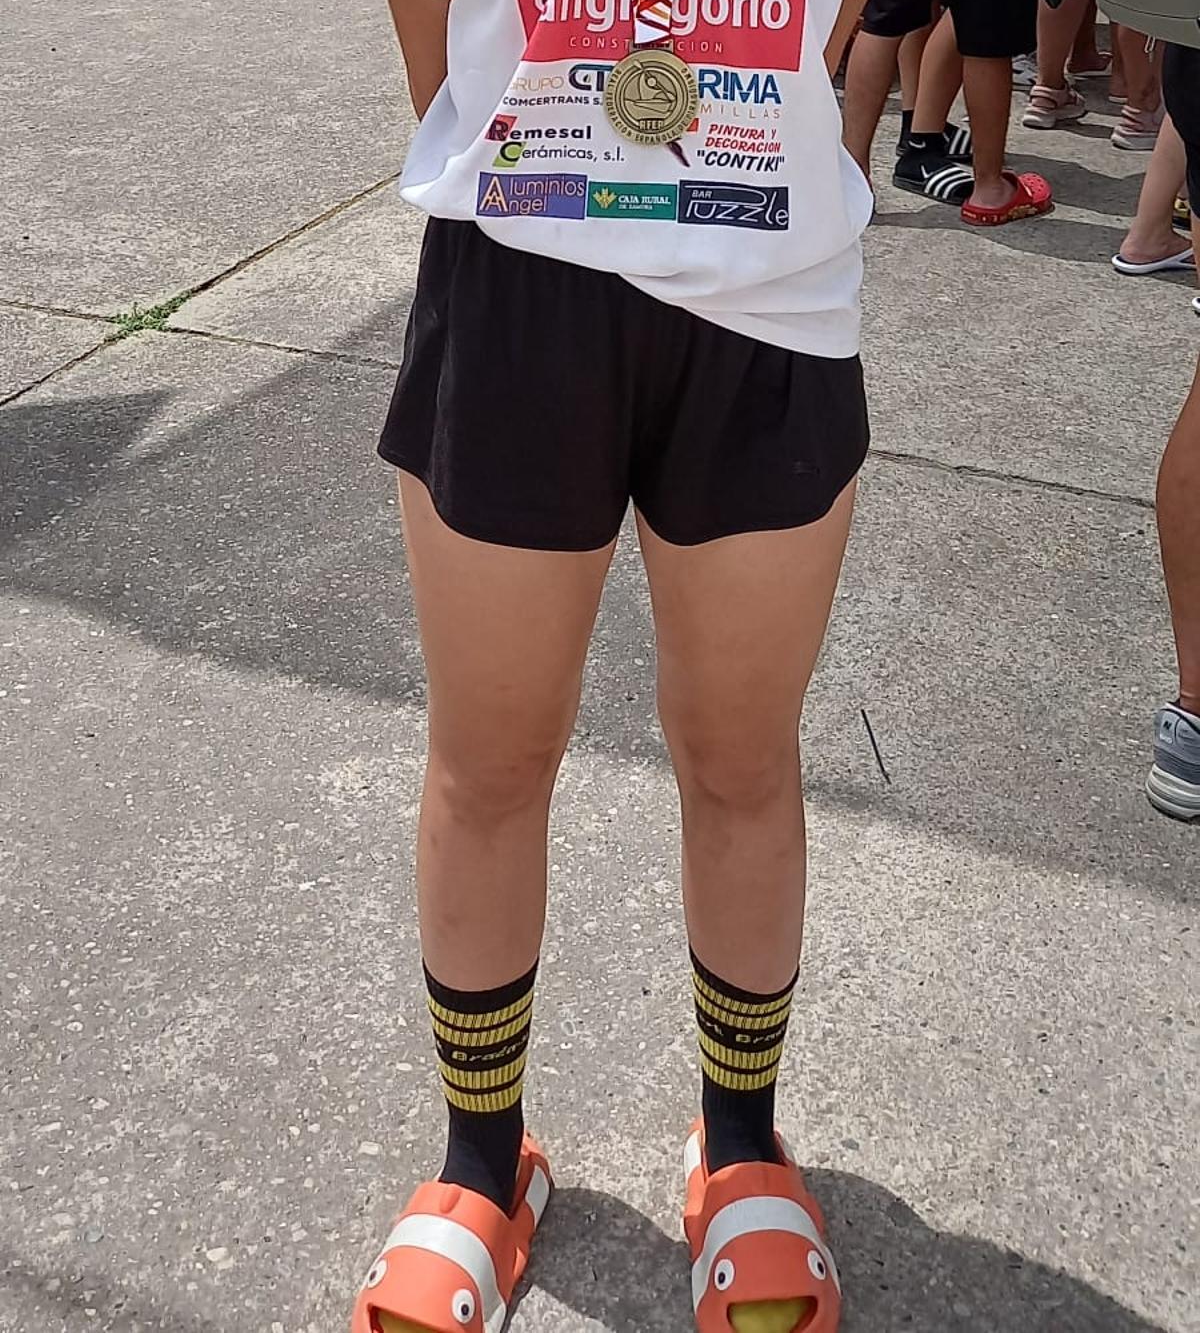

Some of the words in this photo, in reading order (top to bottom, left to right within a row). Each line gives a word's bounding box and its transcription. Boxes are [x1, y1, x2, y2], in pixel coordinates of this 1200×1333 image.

[487, 119, 592, 142] Remesal
[708, 124, 765, 140] PINTURA
[771, 129, 777, 140] Y
[499, 141, 598, 163] Cerámicas,
[603, 146, 625, 162] s.l.
[705, 137, 781, 154] DECORACION
[697, 150, 785, 173] "CONTIKI"
[618, 195, 640, 204] CAJA
[692, 190, 713, 199] BAR
